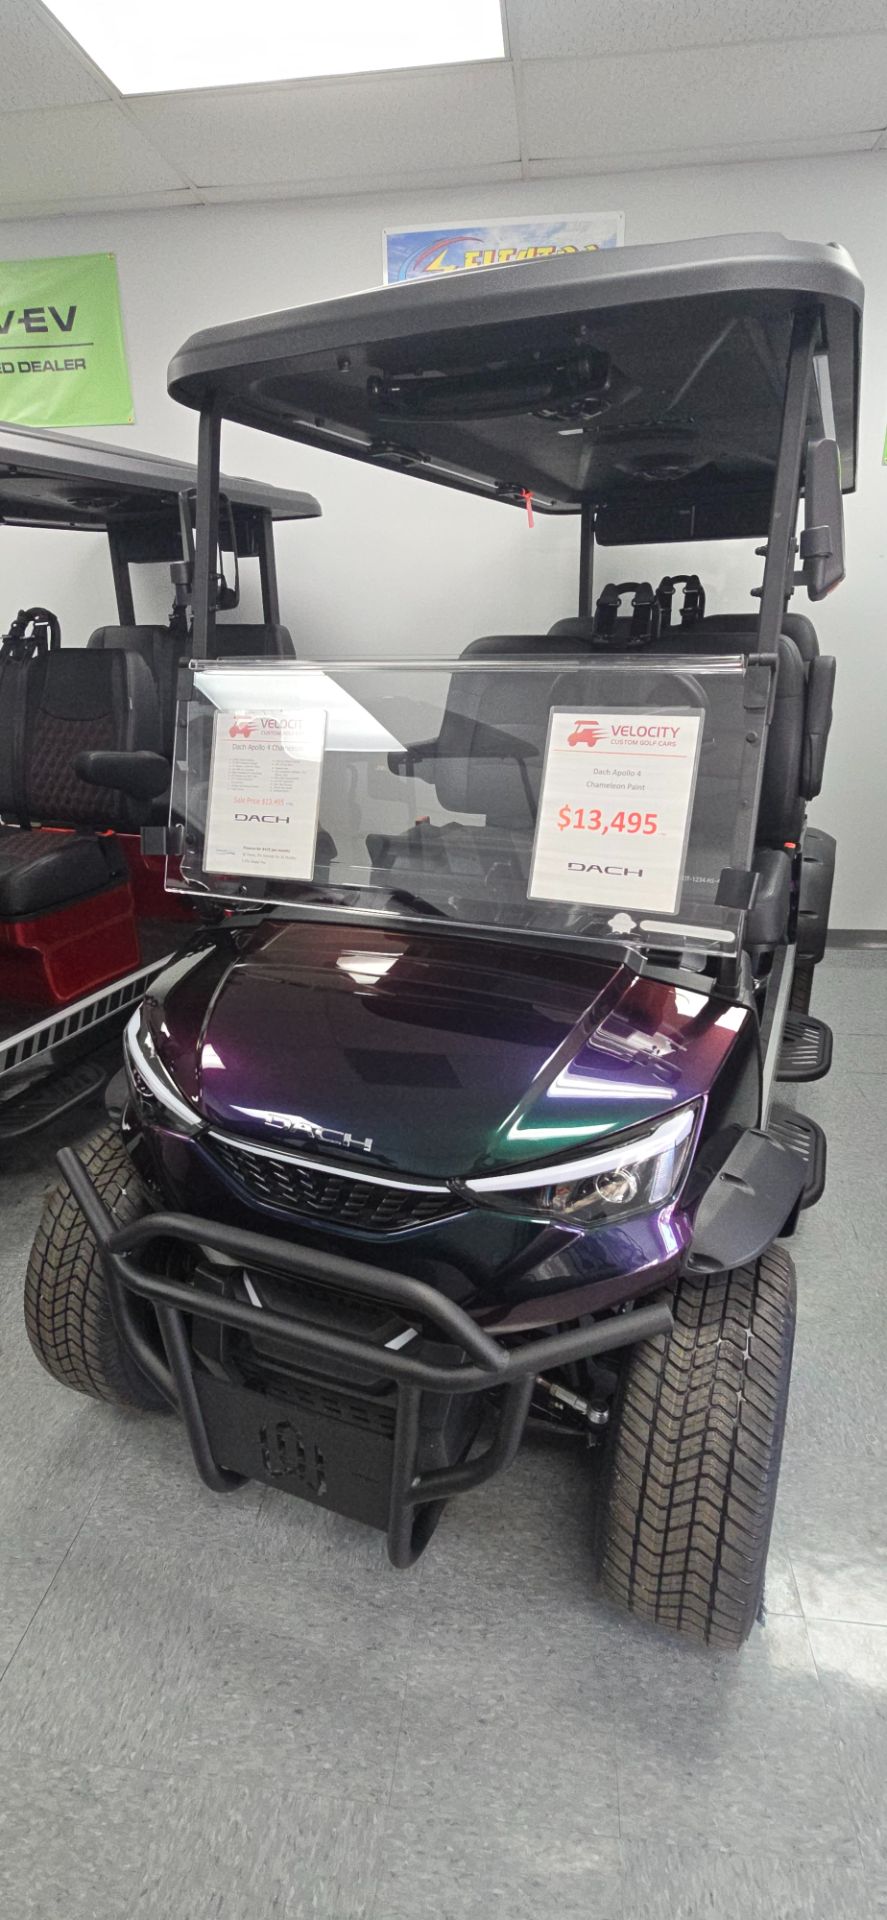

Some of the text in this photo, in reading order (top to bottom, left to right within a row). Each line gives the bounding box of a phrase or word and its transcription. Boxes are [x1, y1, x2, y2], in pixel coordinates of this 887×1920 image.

[18, 358, 87, 374] DEALER
[611, 725, 680, 739] VELOCITY
[610, 738, 677, 748] CUSTOM GOLF CARS
[593, 768, 611, 776] Dach
[612, 769, 634, 779] Apollo
[586, 781, 646, 791] Chameleon Paint
[234, 813, 290, 824] DACH
[557, 804, 658, 836] $13,495
[567, 862, 643, 877] DACH
[263, 1111, 373, 1152] DACH
